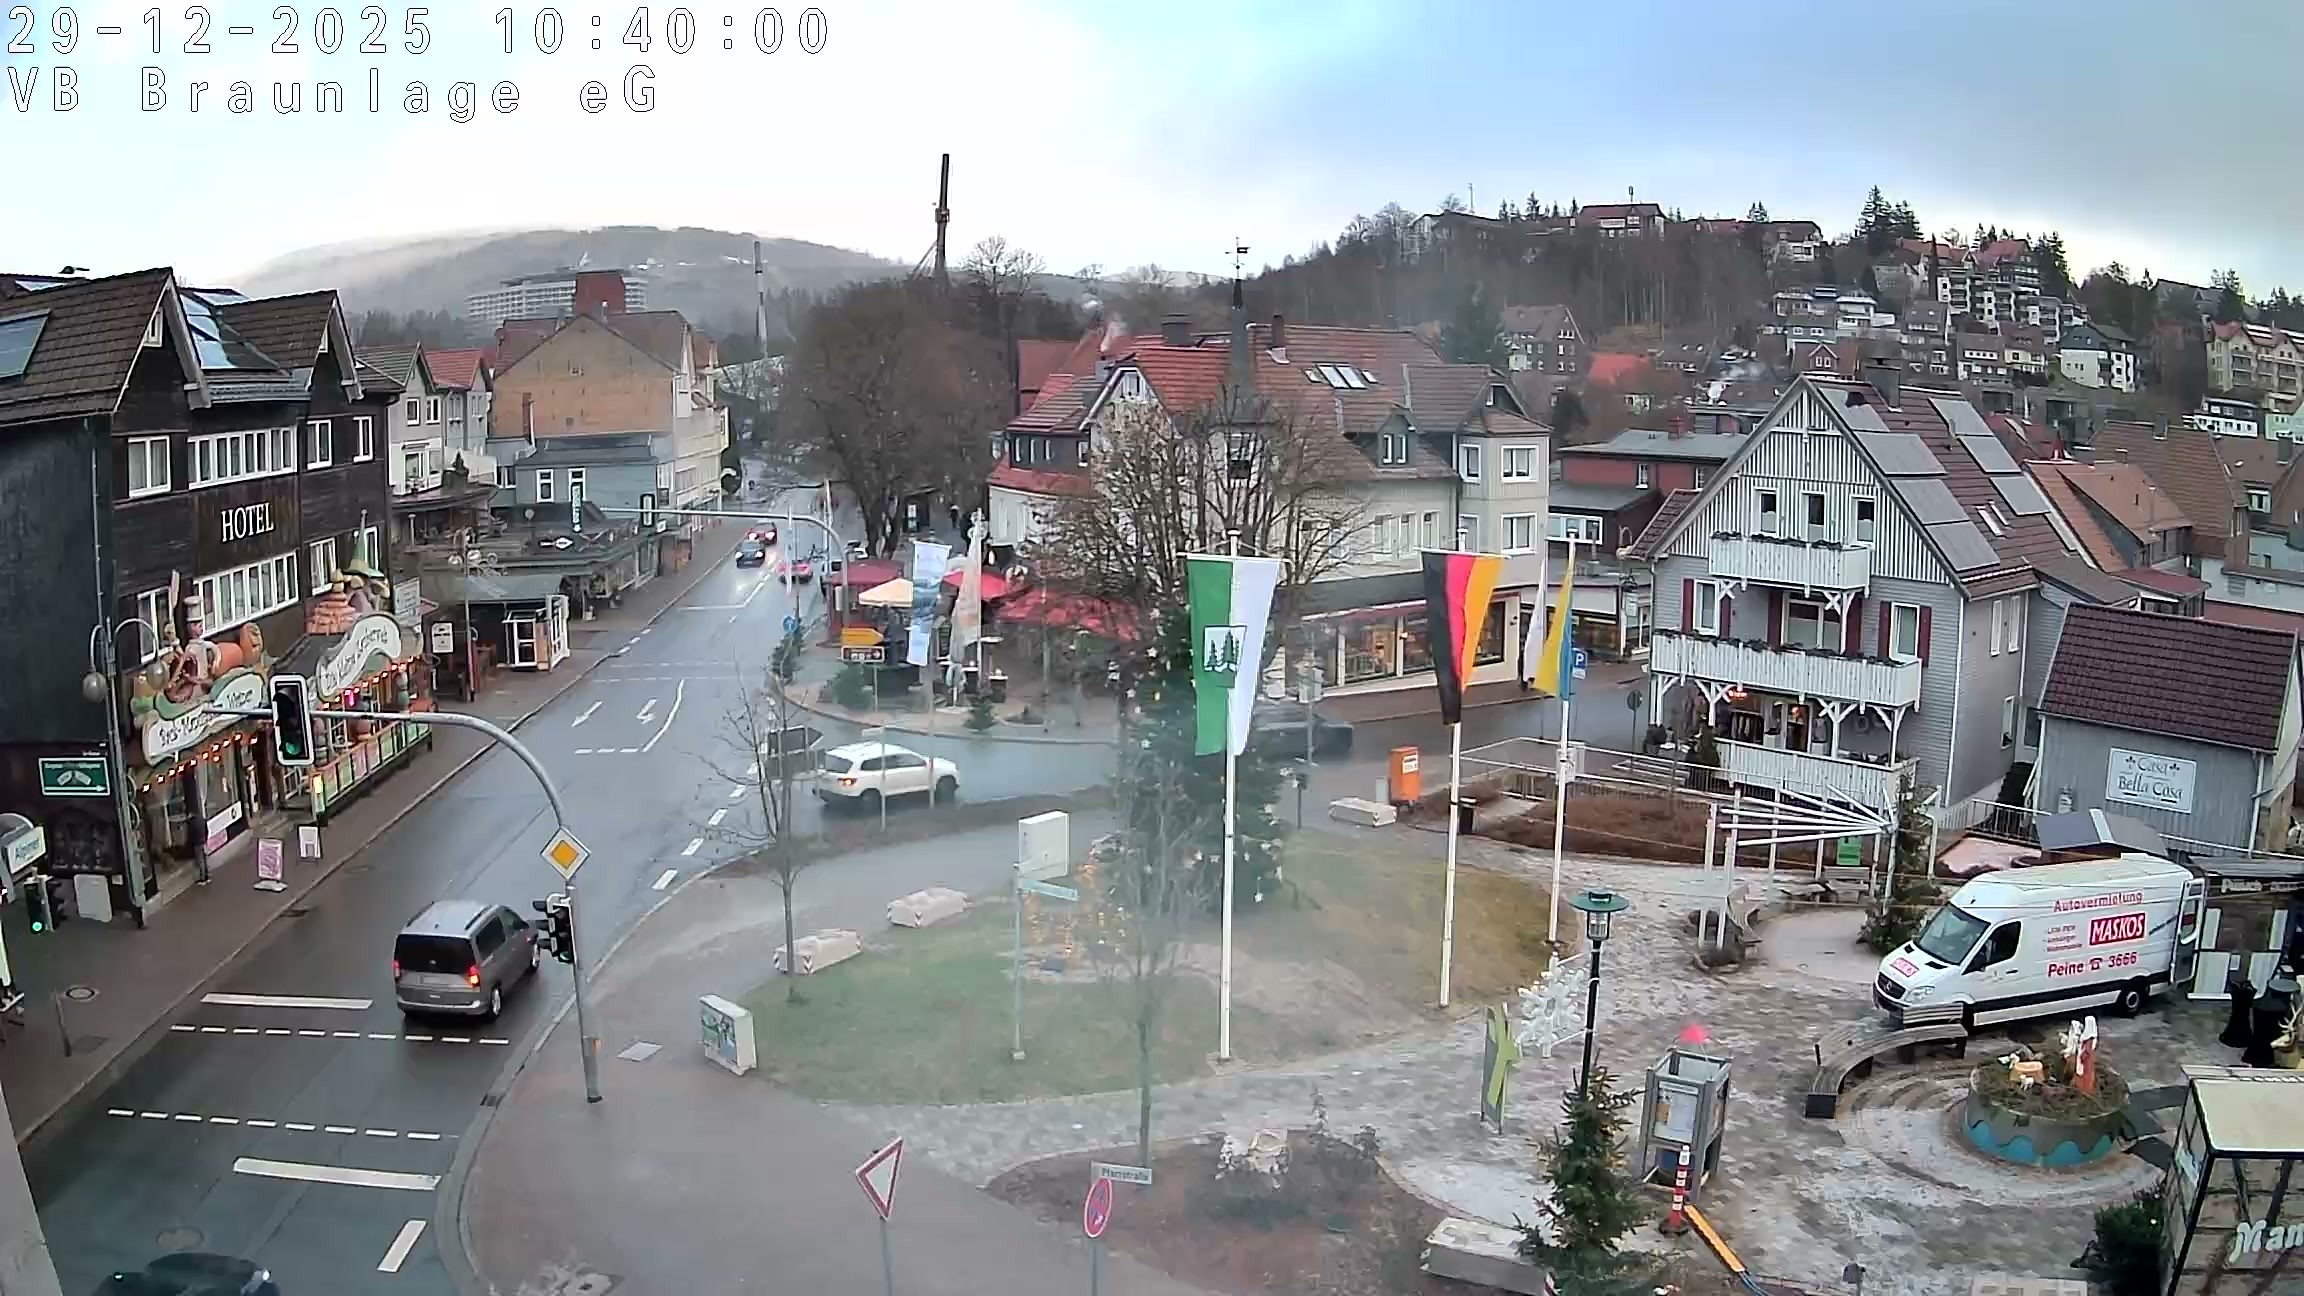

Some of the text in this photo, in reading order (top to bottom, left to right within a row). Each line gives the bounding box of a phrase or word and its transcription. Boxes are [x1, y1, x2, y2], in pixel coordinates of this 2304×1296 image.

[221, 502, 274, 542] HOTEL
[1575, 652, 1585, 667] P
[2118, 773, 2148, 793] Bella
[2053, 892, 2144, 913] Autovermietung
[2091, 915, 2144, 944] MASKOS
[2047, 951, 2137, 977] Peine 3666
